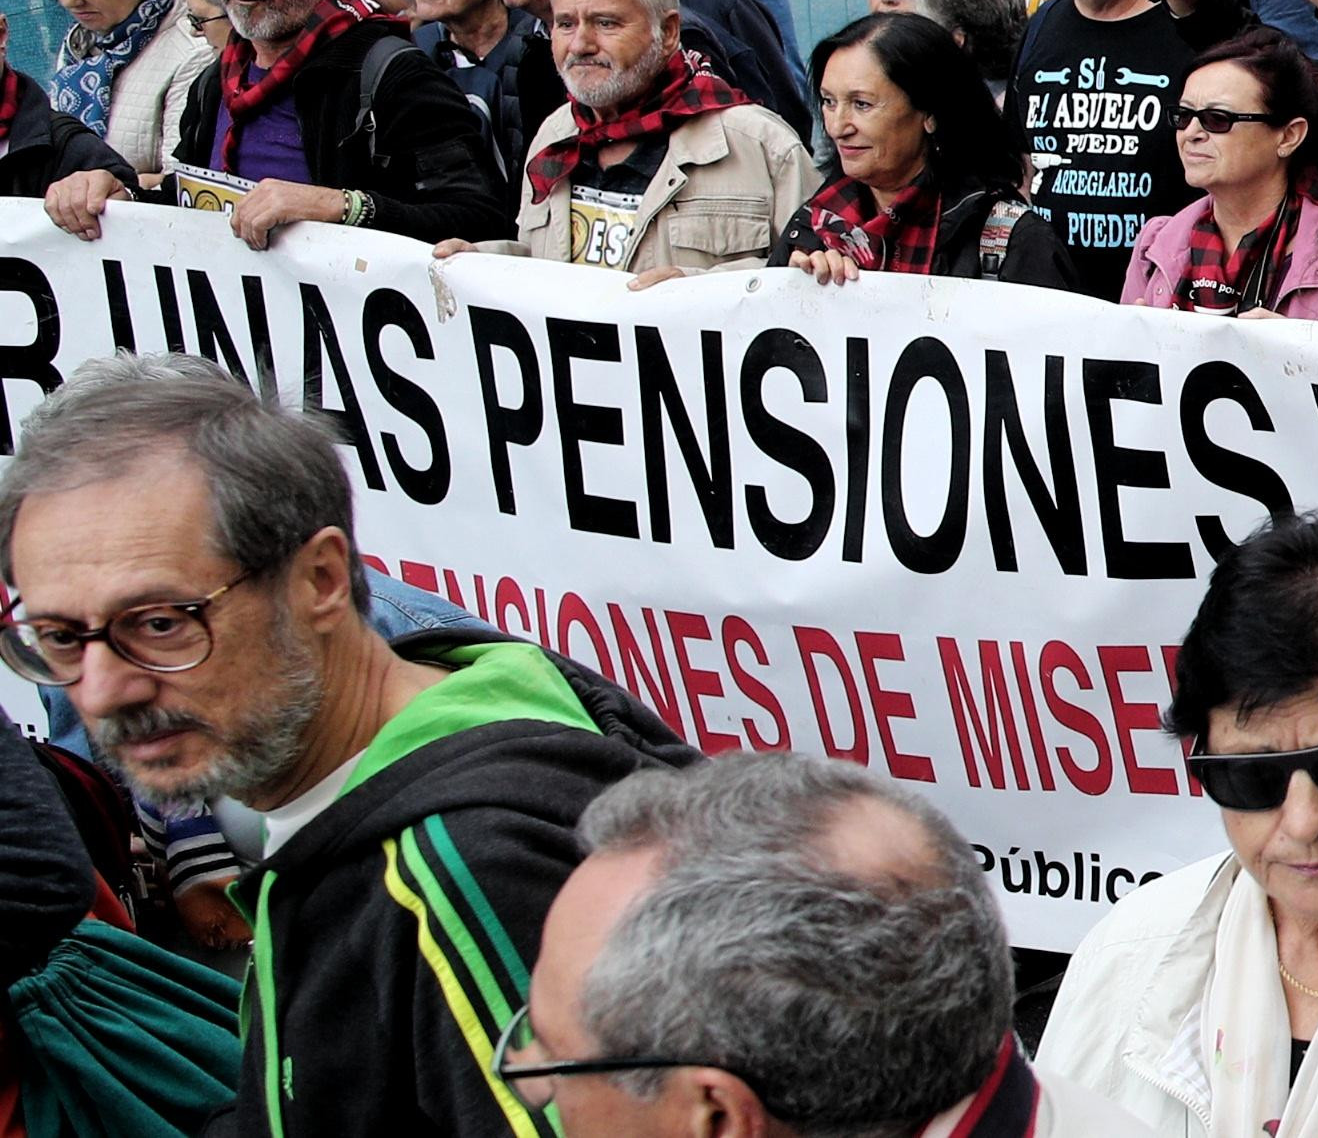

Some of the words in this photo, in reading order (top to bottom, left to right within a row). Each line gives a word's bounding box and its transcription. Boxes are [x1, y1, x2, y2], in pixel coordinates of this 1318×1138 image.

[1053, 92, 1161, 131] ABUELO
[1033, 135, 1057, 152] NO
[1065, 134, 1139, 155] PUEDE
[1052, 169, 1152, 198] ARREGLARLO
[468, 304, 1294, 580] PENSIONES
[792, 625, 937, 784] DE
